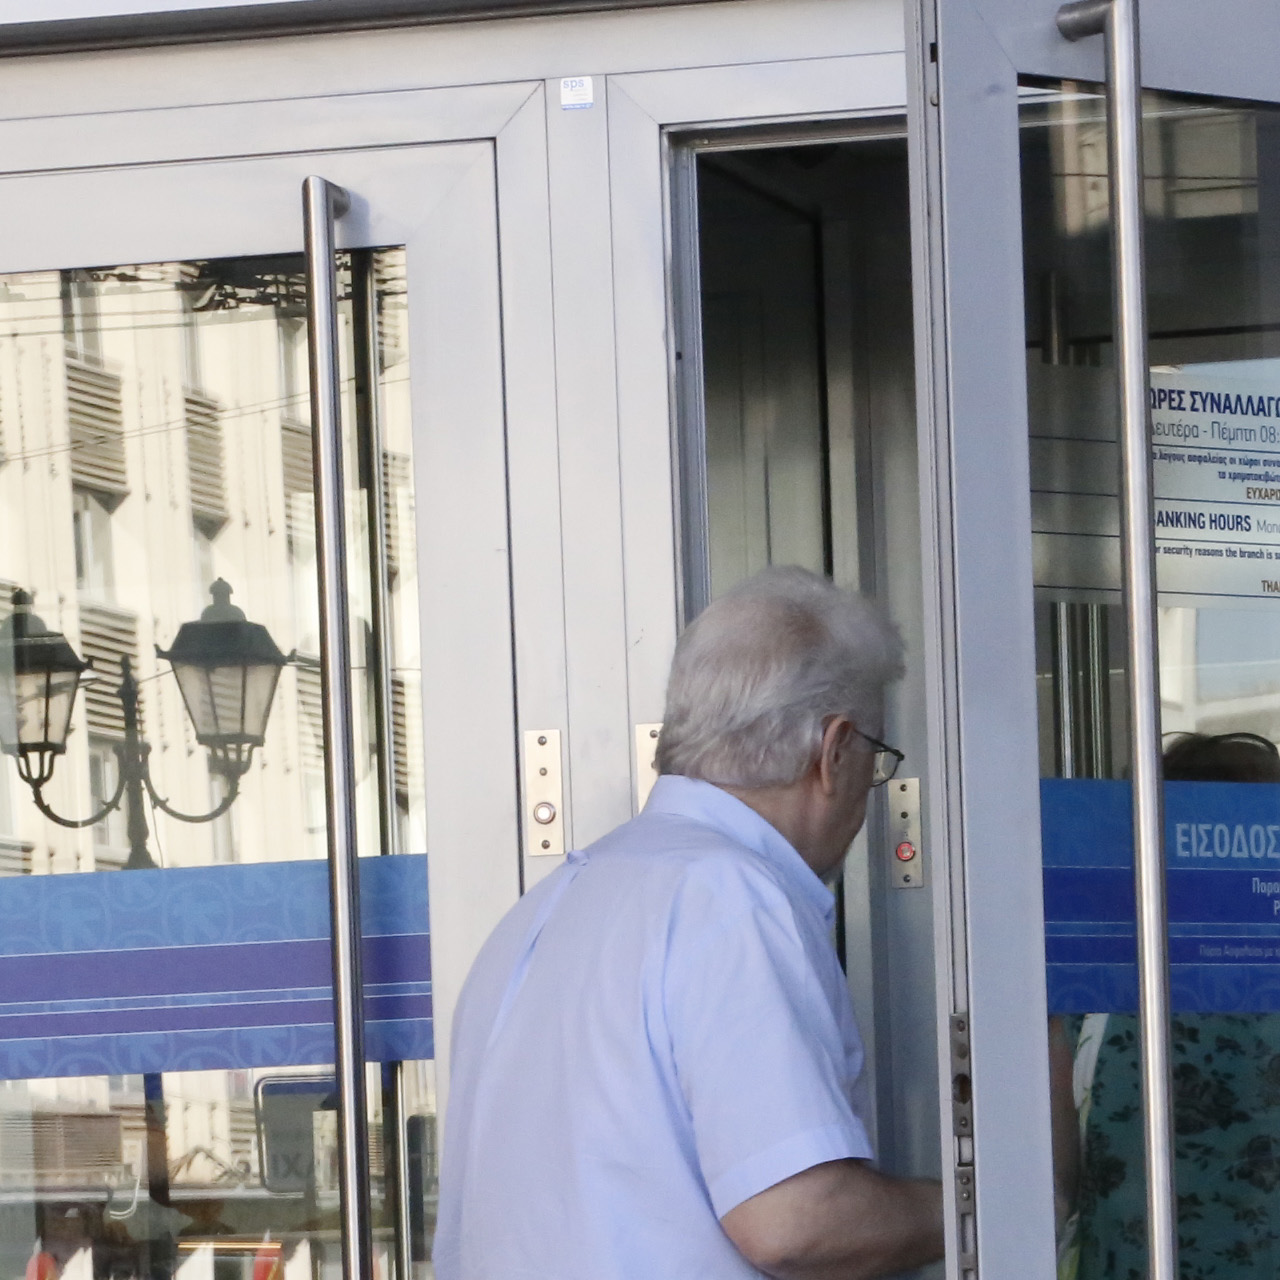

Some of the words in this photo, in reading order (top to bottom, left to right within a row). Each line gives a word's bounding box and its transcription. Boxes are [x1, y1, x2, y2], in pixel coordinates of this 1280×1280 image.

[563, 79, 585, 91] sps
[1211, 421, 1257, 445] Πέμπτη
[1154, 511, 1205, 530] ANKING
[1210, 514, 1252, 532] HOURS
[1163, 545, 1193, 558] security
[1195, 548, 1223, 558] reasons
[1226, 547, 1237, 558] the
[1239, 548, 1264, 559] branch
[1266, 549, 1272, 560] is
